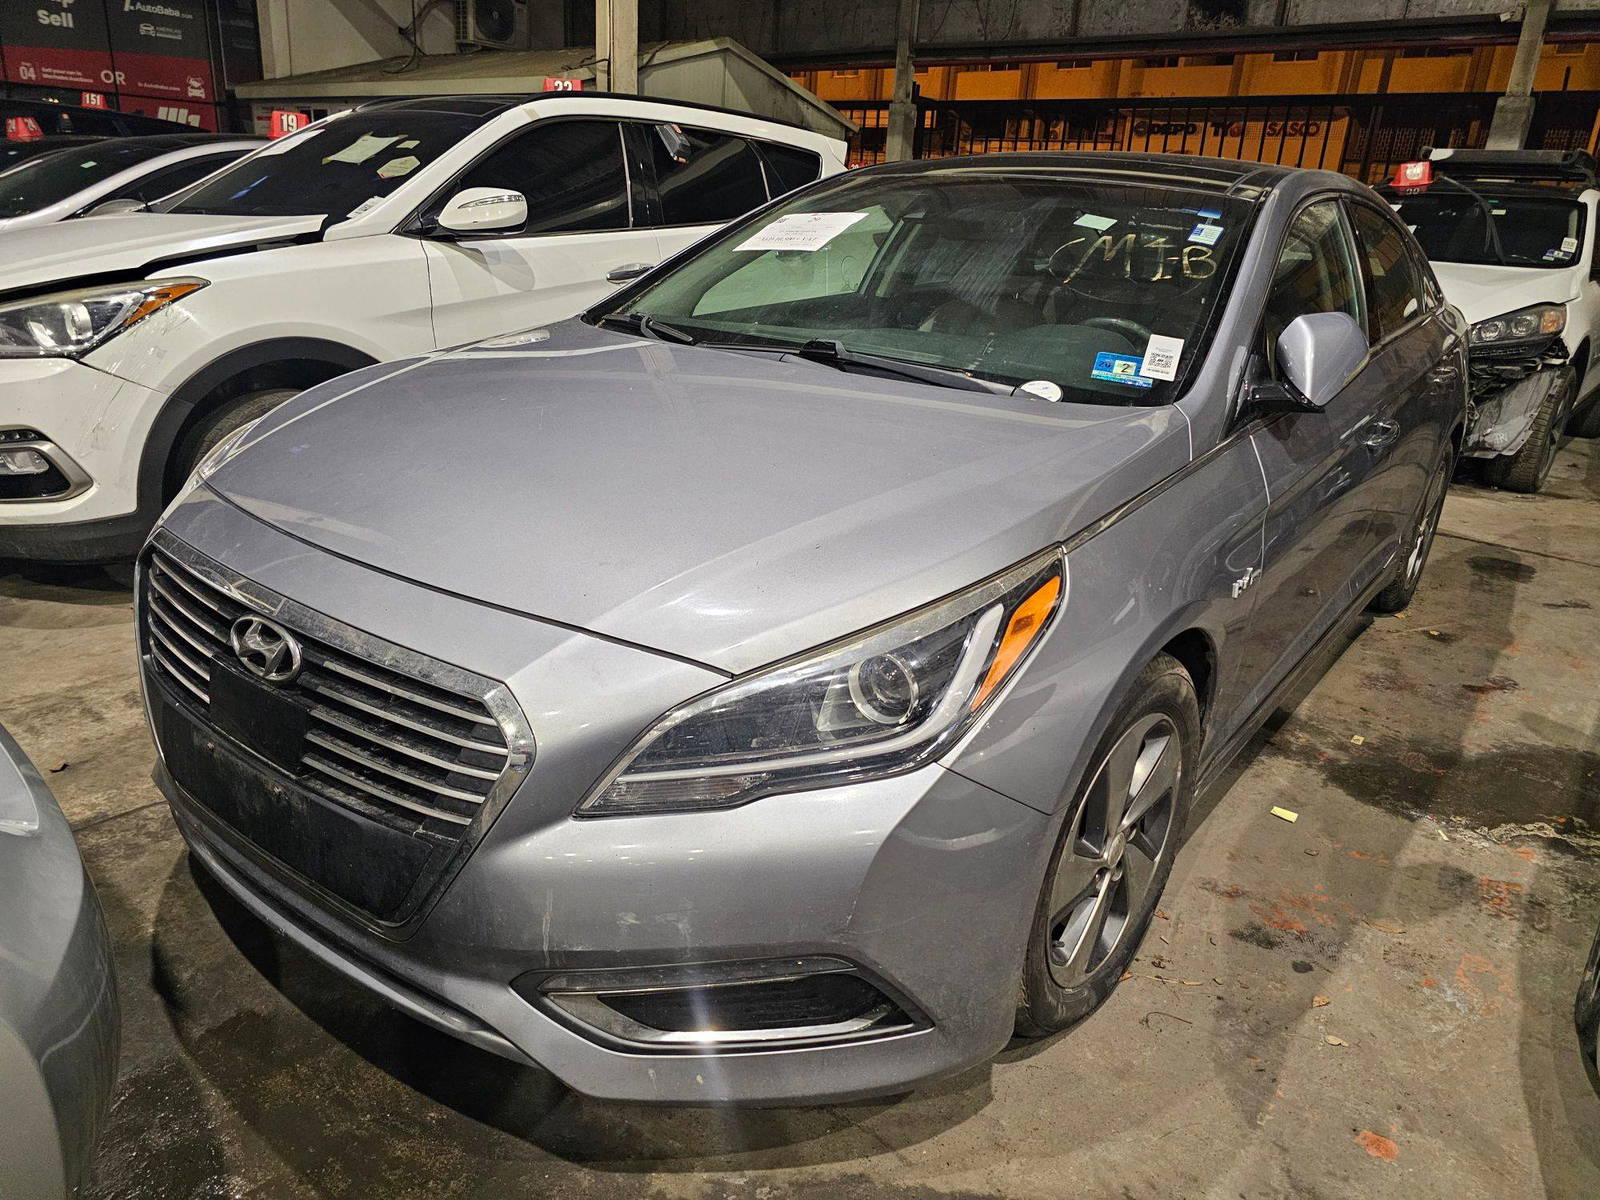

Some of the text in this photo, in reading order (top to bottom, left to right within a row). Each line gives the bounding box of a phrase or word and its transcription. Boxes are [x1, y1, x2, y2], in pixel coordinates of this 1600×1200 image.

[36, 9, 74, 29] Sell
[19, 66, 36, 81] 04
[100, 69, 126, 85] OR
[85, 93, 101, 106] 151
[281, 113, 298, 132] 19
[1265, 121, 1320, 137] SASCO
